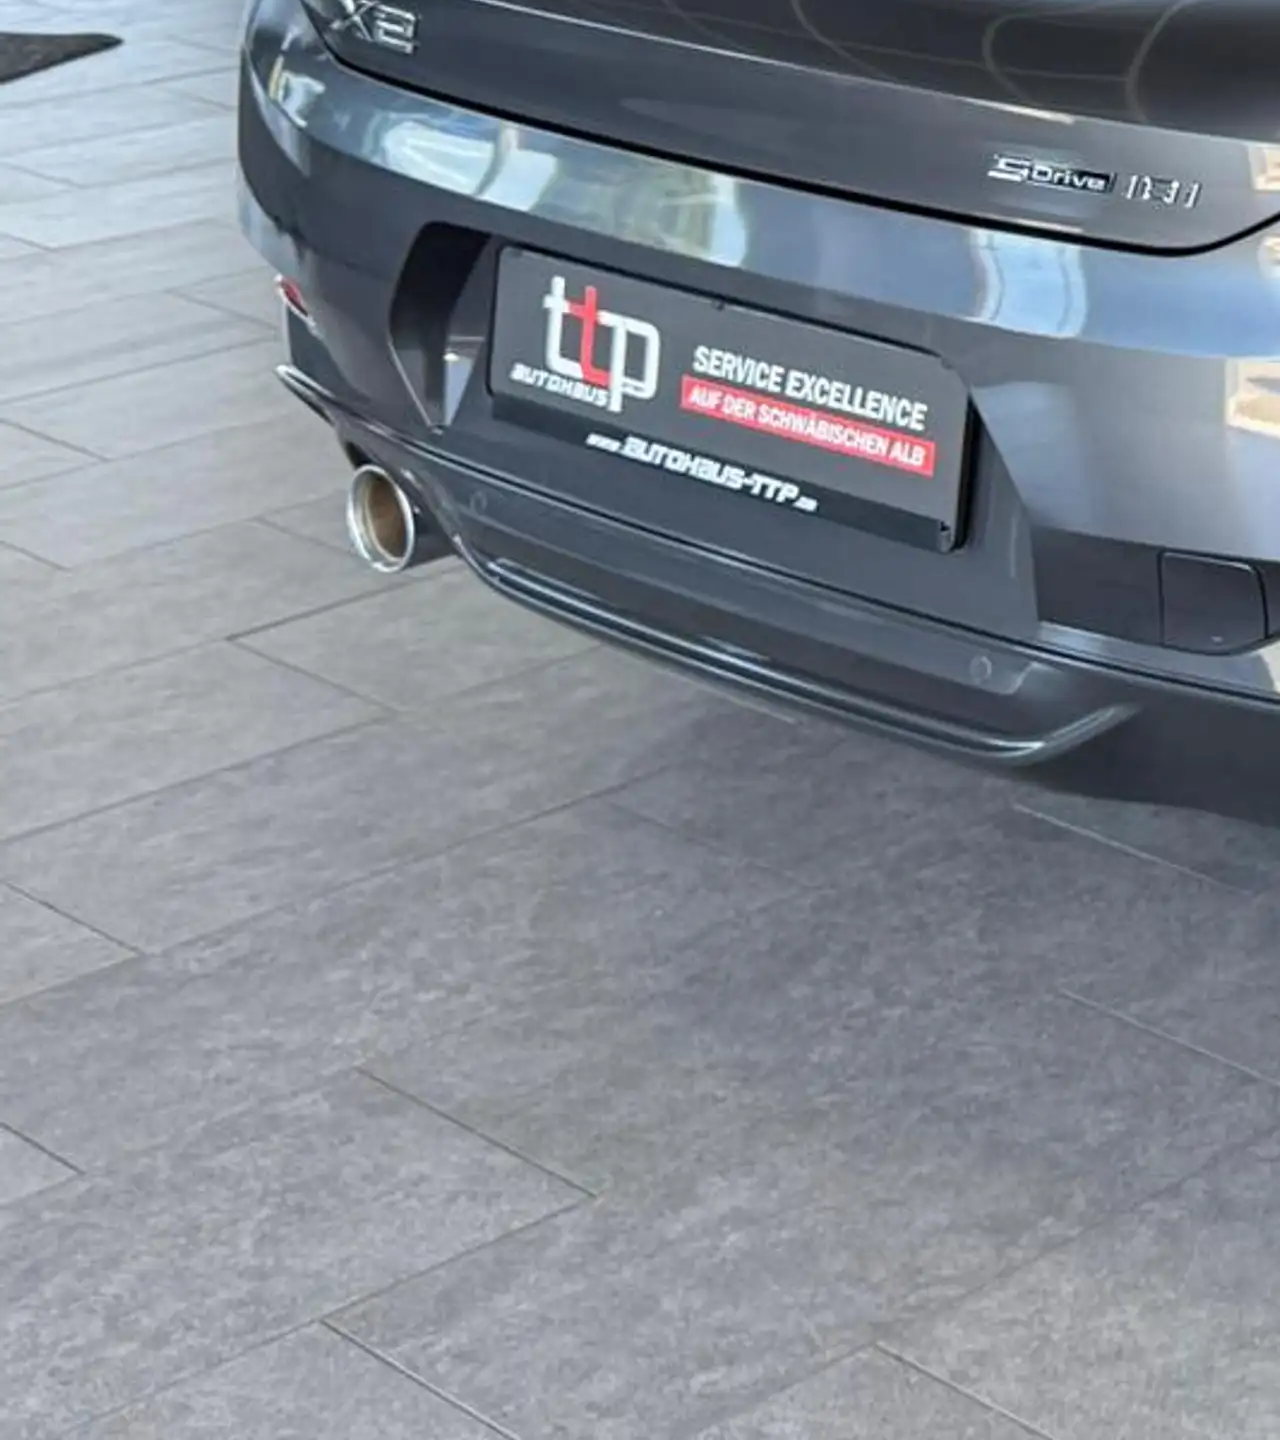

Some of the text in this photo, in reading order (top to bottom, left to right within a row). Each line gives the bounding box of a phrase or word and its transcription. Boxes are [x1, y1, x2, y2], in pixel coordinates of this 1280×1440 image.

[543, 276, 660, 412] ttp
[689, 387, 724, 410] AUF
[722, 397, 757, 420] DER
[888, 440, 926, 466] ALB
[693, 345, 927, 431] SERVICE EXCELLENCE
